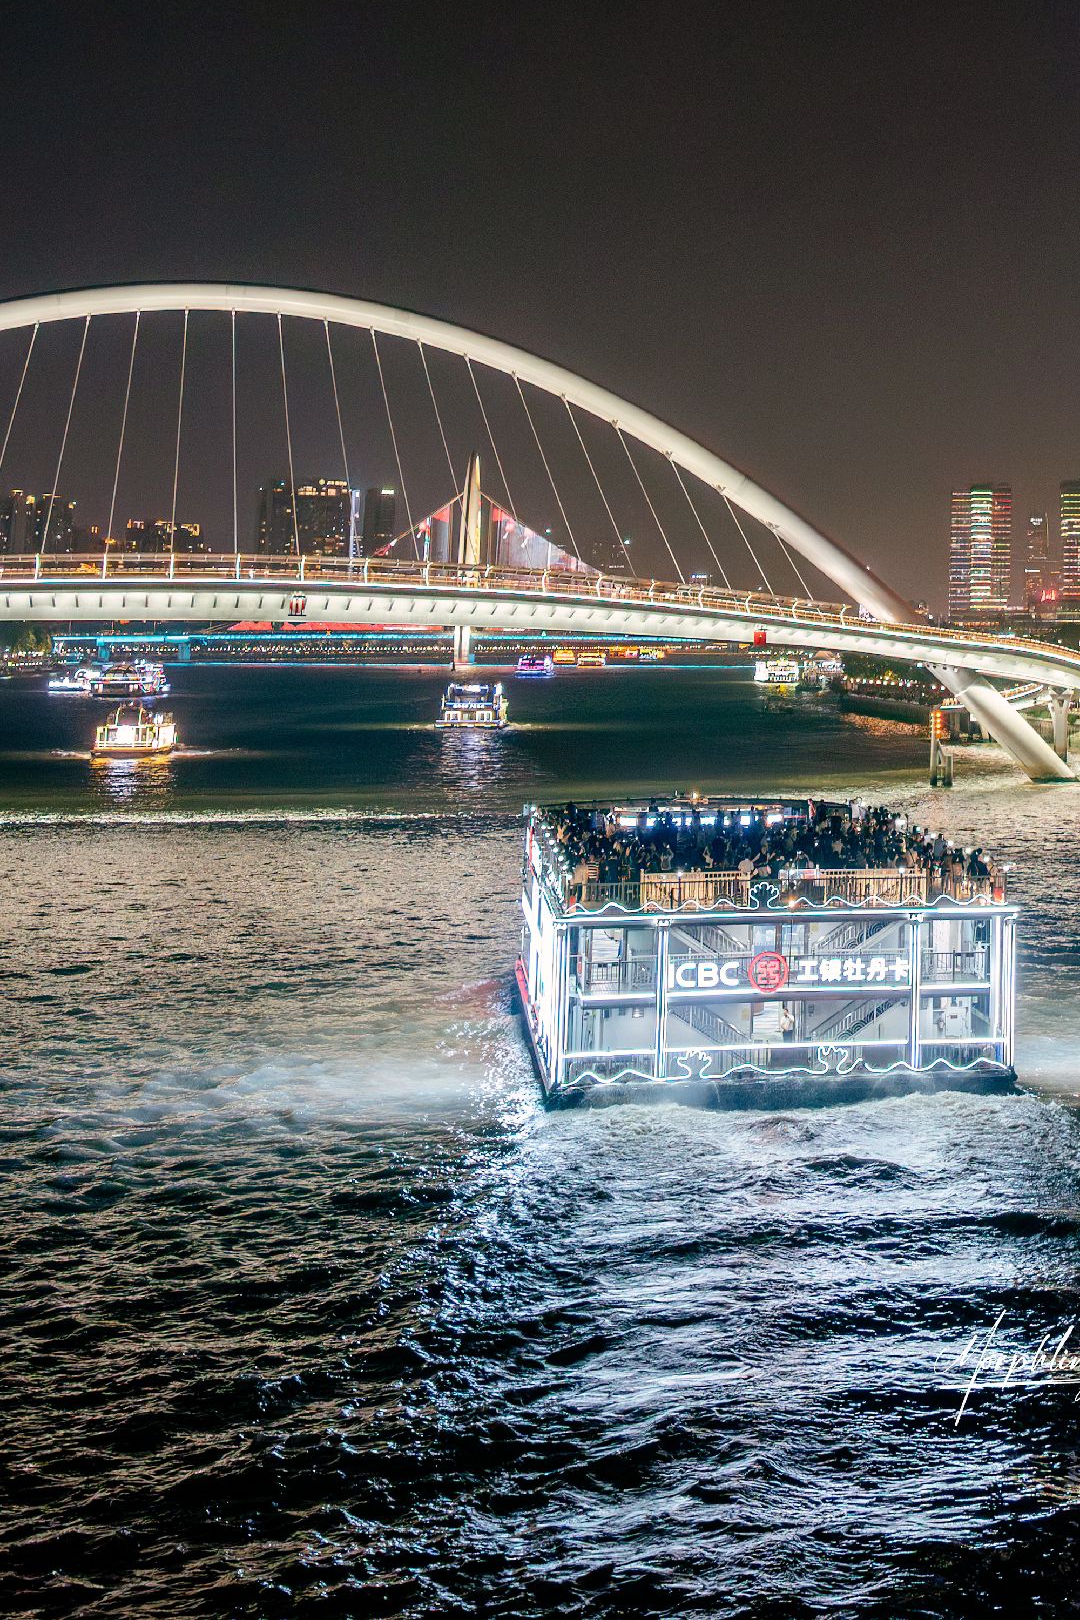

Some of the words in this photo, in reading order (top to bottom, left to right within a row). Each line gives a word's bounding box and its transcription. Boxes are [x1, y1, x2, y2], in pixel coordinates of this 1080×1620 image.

[668, 961, 740, 988] ICBC
[796, 956, 910, 982] 工银牡丹卡
